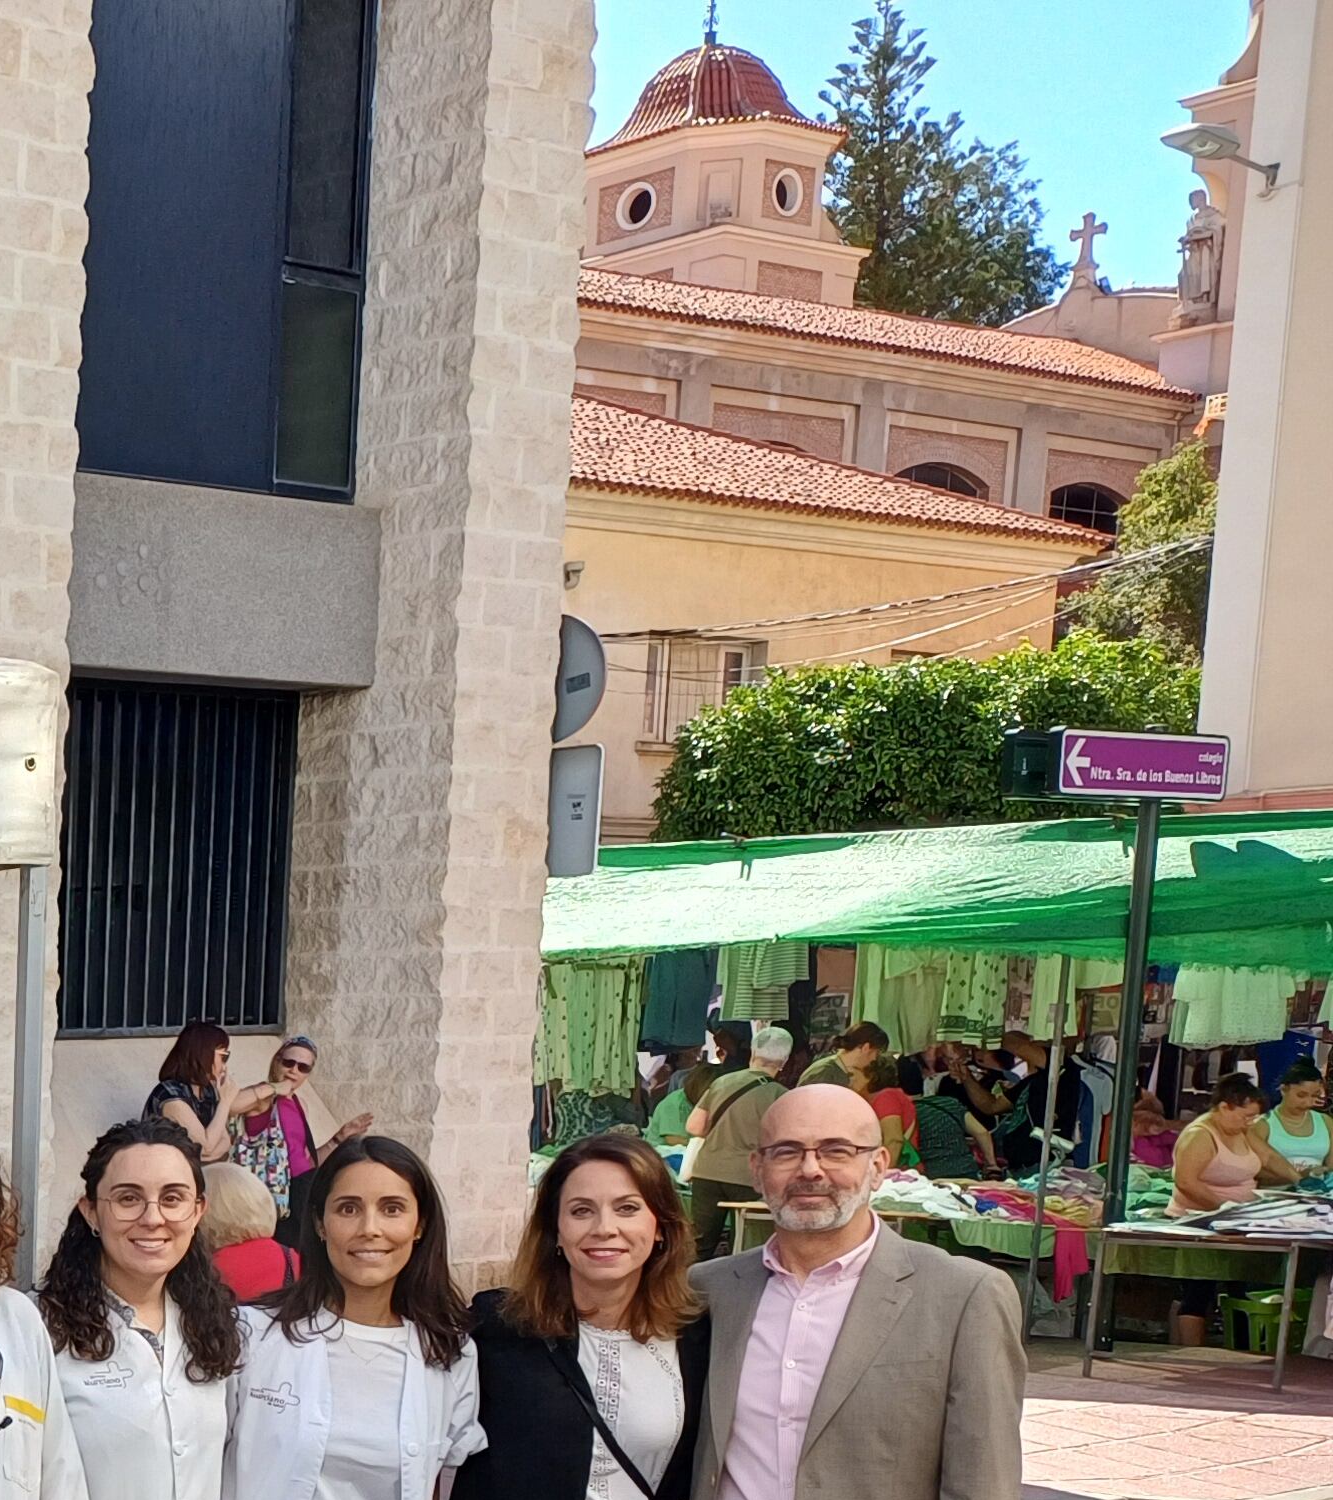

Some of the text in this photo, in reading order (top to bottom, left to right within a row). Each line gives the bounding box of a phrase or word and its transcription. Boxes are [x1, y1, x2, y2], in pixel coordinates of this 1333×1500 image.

[1090, 766, 1221, 785] Ntra. Sra. de los Buenos Libros
